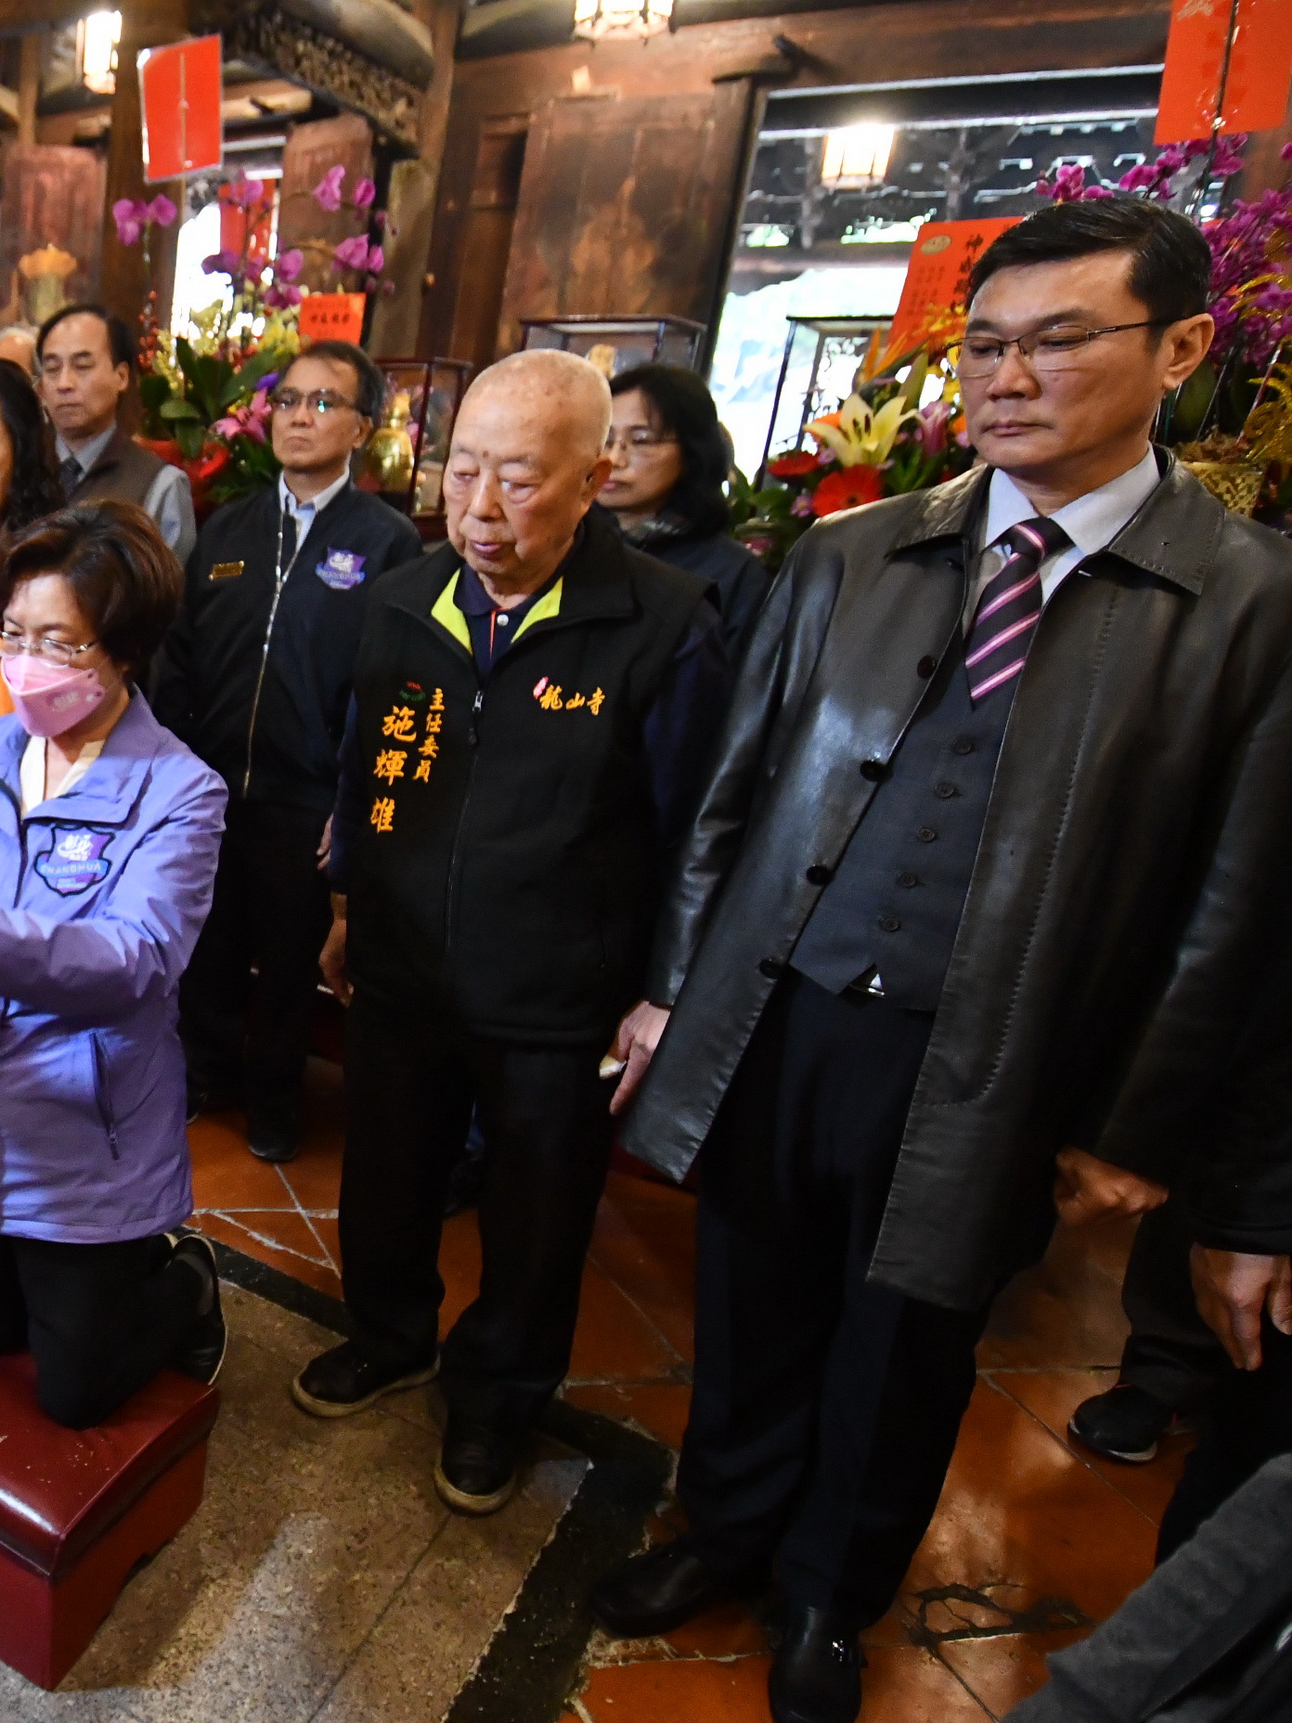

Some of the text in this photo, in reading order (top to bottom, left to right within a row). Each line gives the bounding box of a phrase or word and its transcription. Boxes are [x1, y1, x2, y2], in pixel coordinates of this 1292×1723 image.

[412, 687, 446, 783] 主任委員
[539, 684, 606, 716] 龍山寺
[370, 705, 417, 834] 施輝雄
